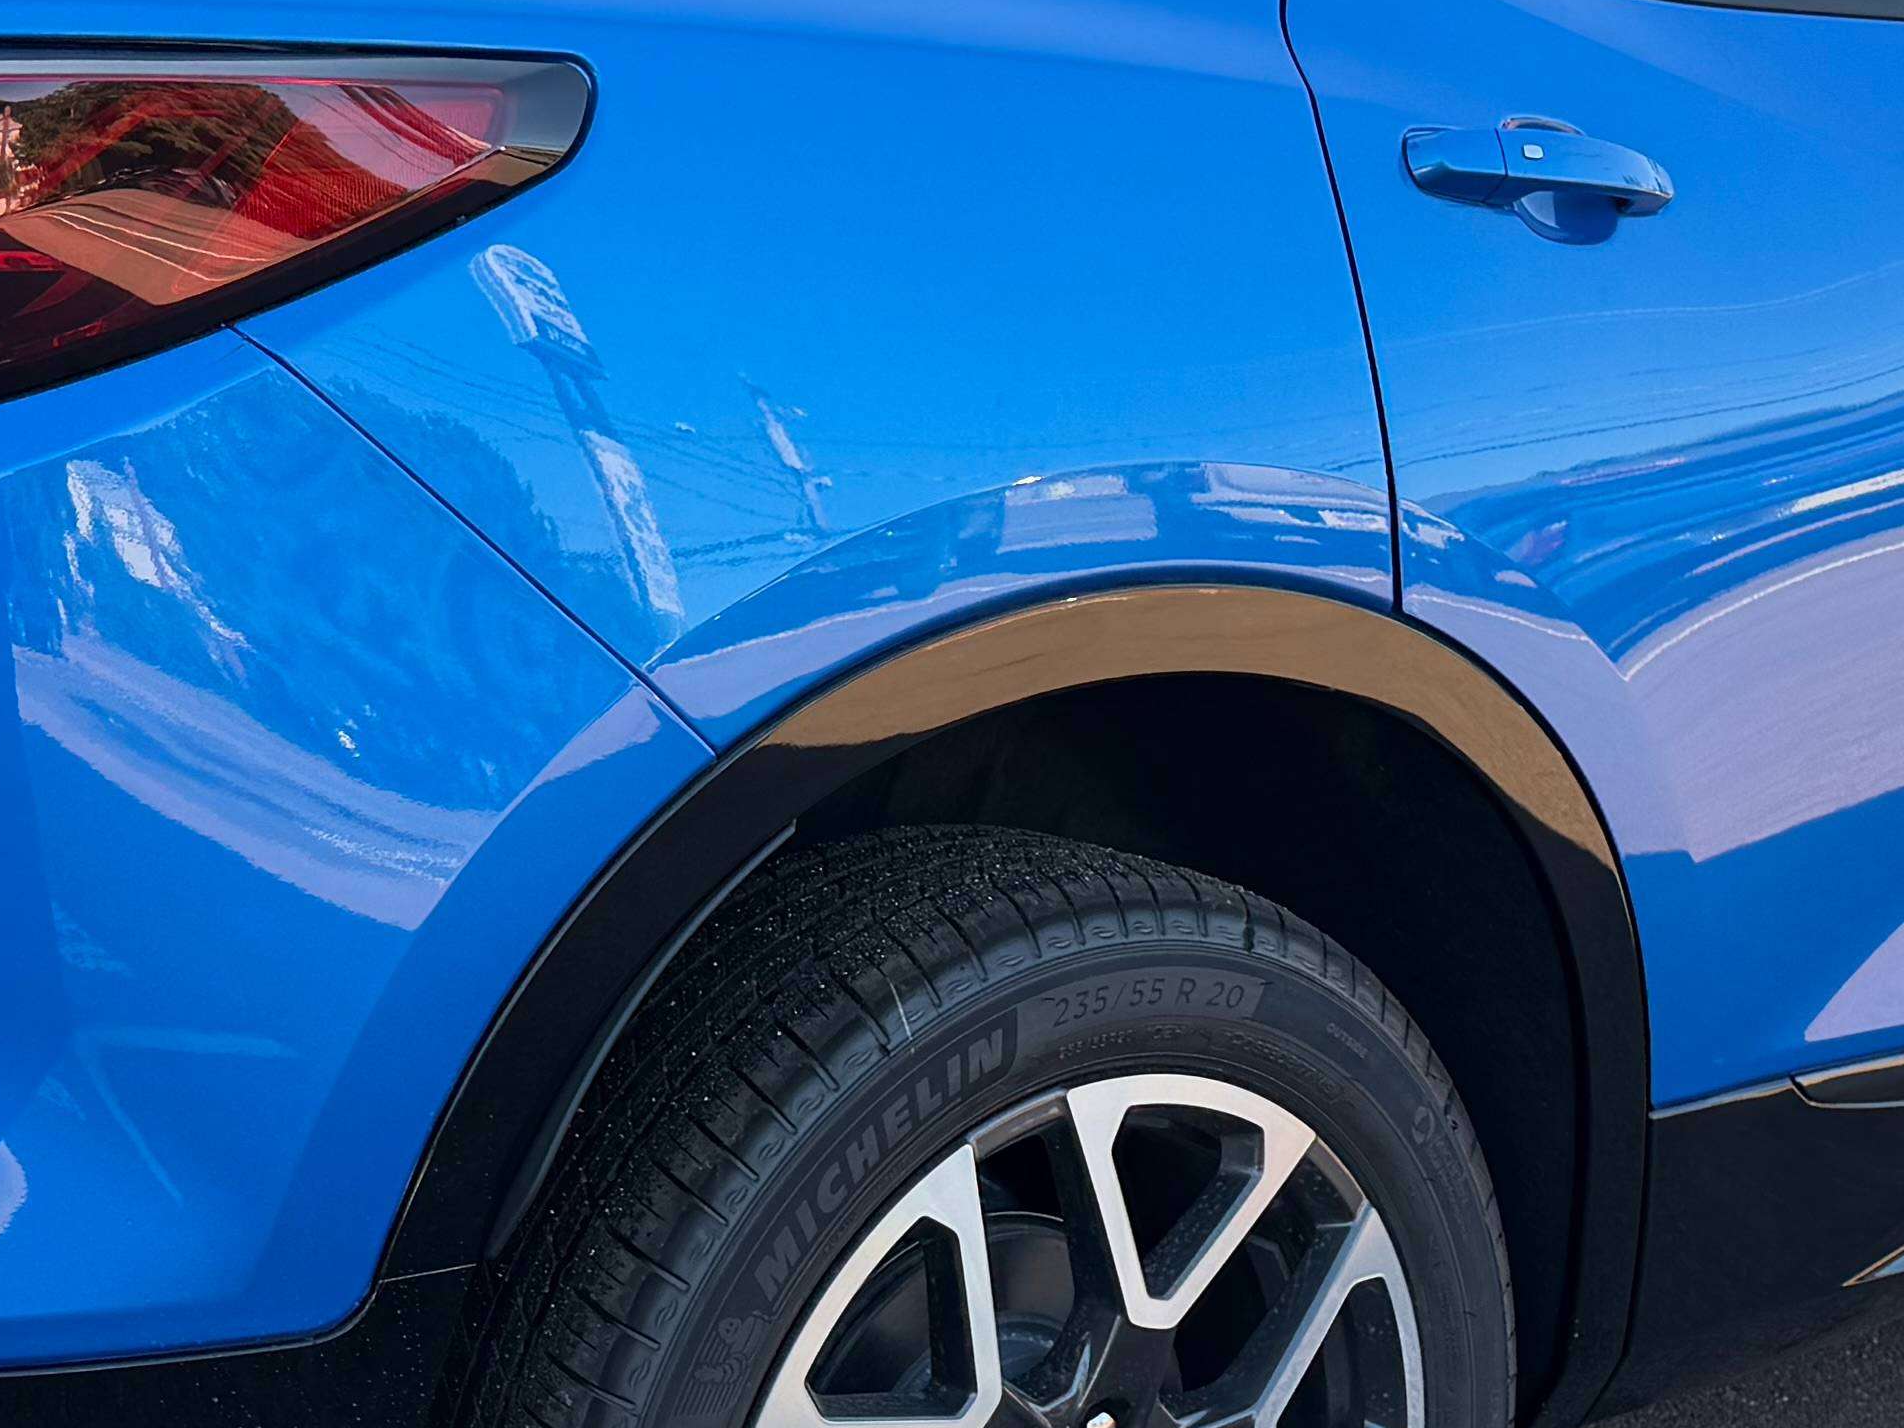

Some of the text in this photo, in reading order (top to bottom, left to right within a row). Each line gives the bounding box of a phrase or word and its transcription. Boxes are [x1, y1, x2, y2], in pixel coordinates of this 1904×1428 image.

[1053, 977, 1245, 1028] 235/55 R 20
[753, 1028, 1003, 1302] MICHELIN
